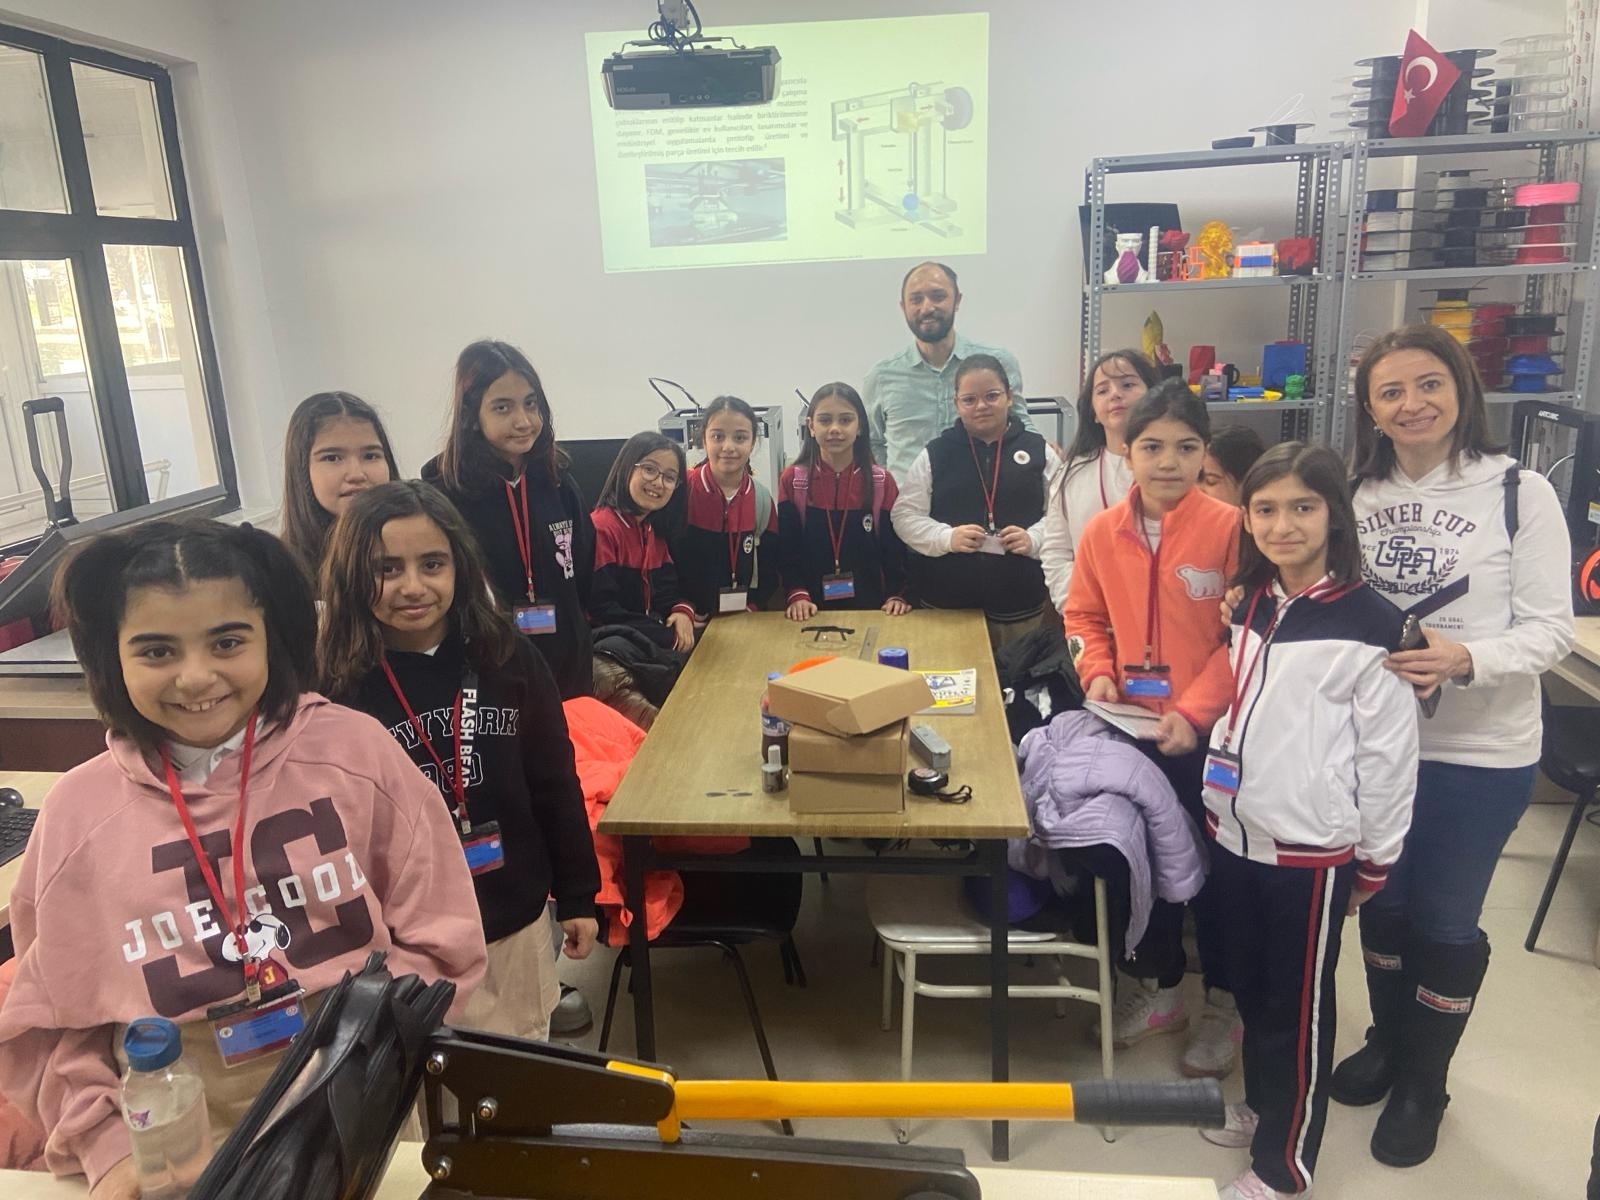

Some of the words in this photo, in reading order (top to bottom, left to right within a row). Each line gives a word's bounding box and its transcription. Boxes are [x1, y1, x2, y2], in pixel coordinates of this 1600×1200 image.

[1356, 503, 1423, 534] SILVER
[1432, 509, 1476, 537] CUP
[460, 688, 477, 741] FLASH
[122, 898, 221, 963] JOE
